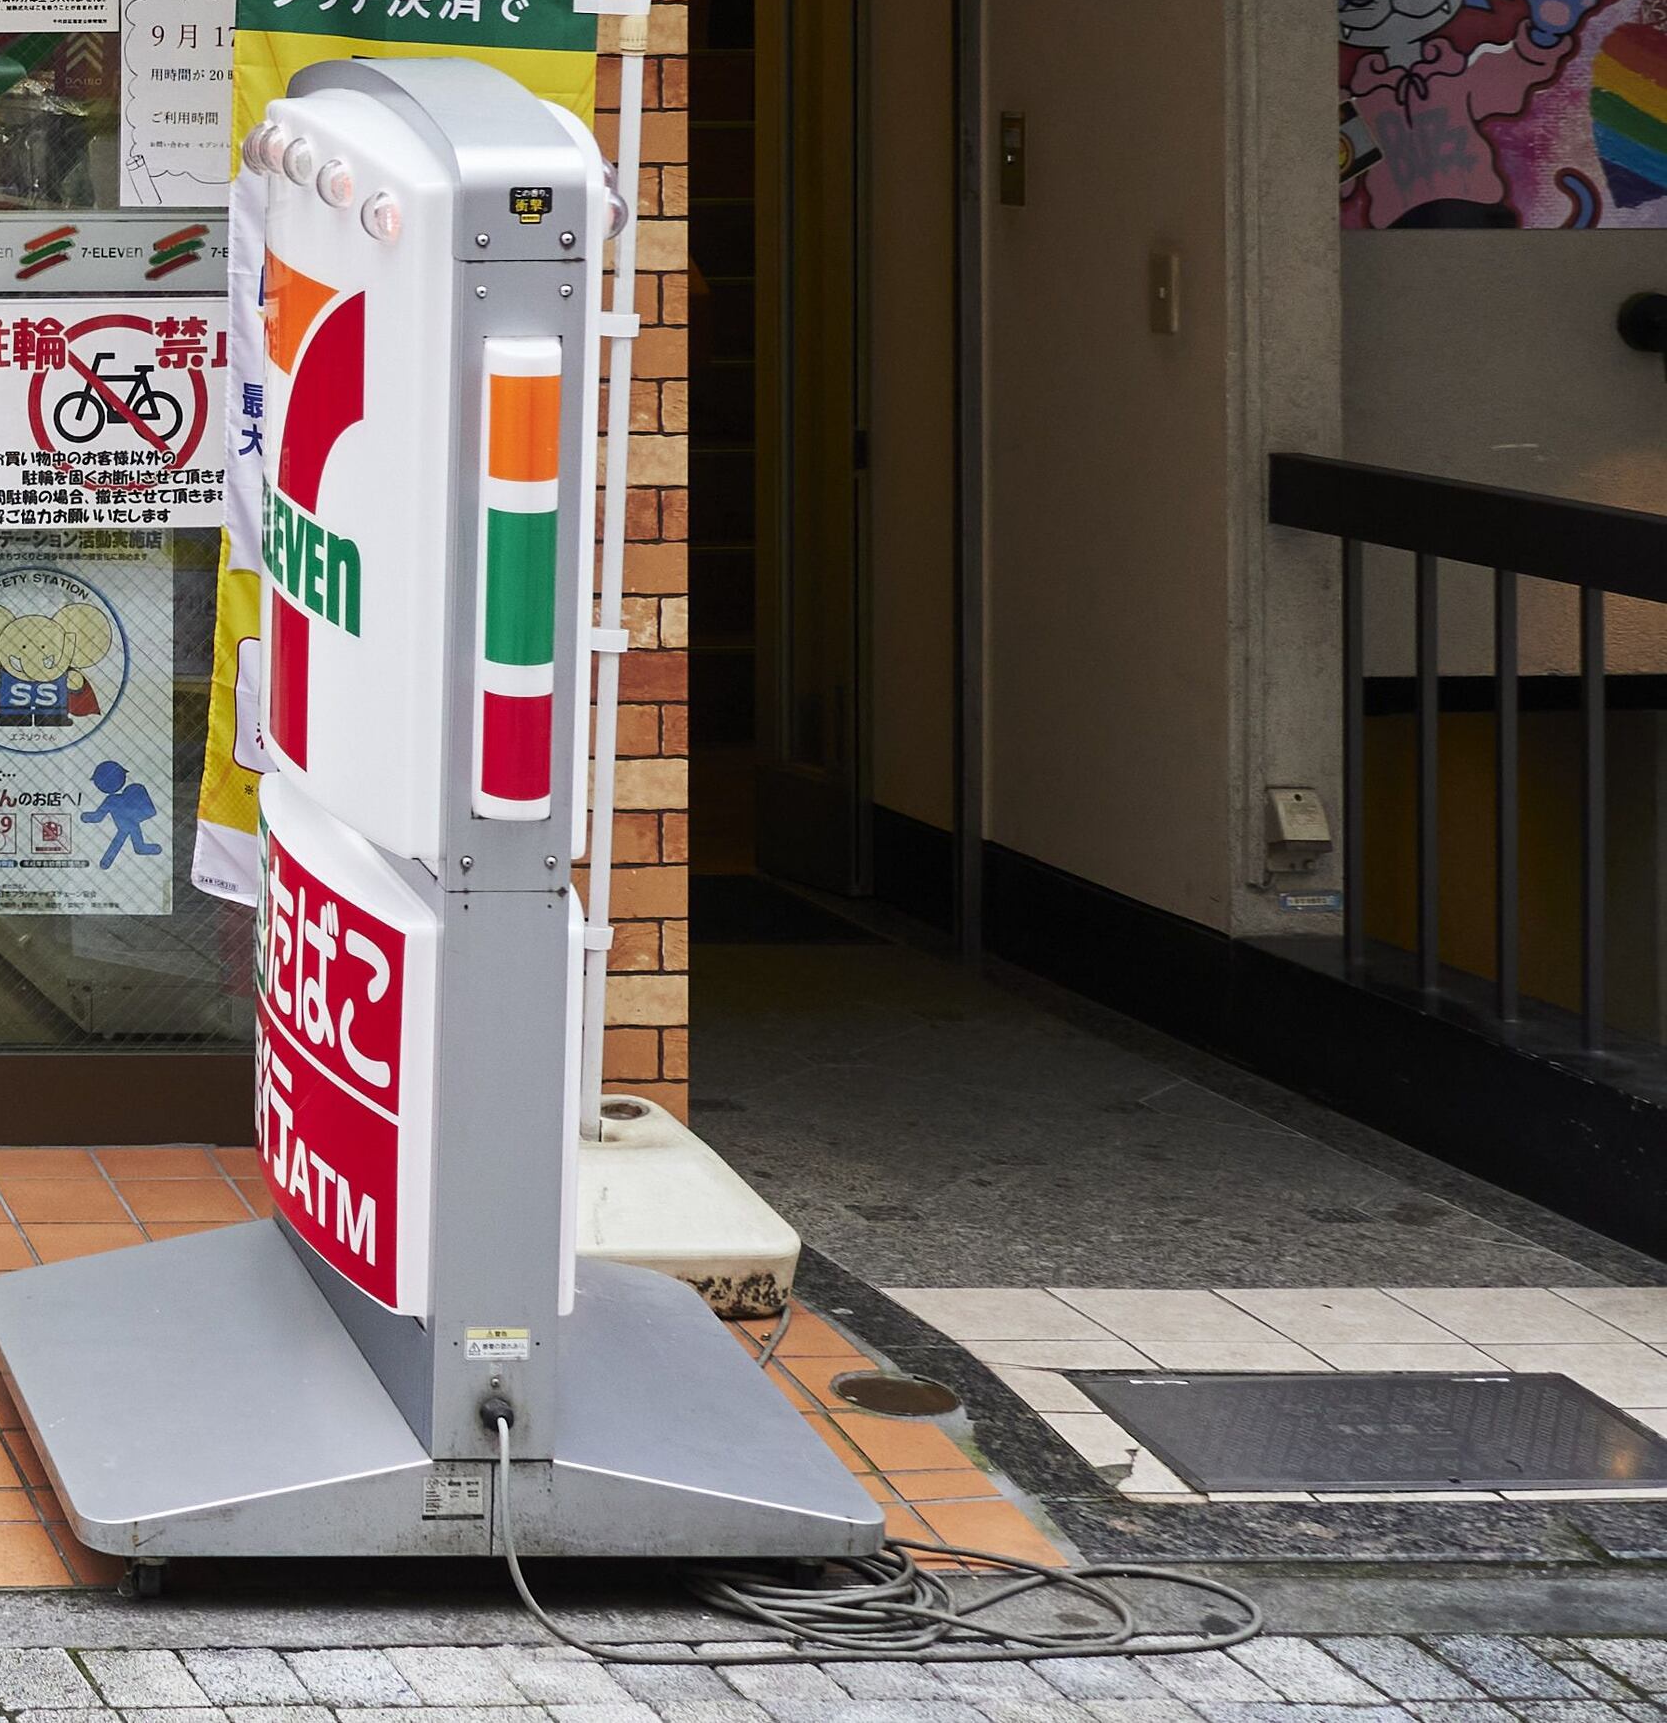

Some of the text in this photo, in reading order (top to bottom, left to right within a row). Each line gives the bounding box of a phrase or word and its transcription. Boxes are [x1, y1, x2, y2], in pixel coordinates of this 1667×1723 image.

[151, 111, 219, 125] ご利用時間
[32, 573, 90, 601] STATION
[9, 681, 59, 707] SS
[9, 731, 58, 743] エスゾウくん
[269, 855, 391, 1089] たばこ
[255, 1012, 377, 1267] 行ATM
